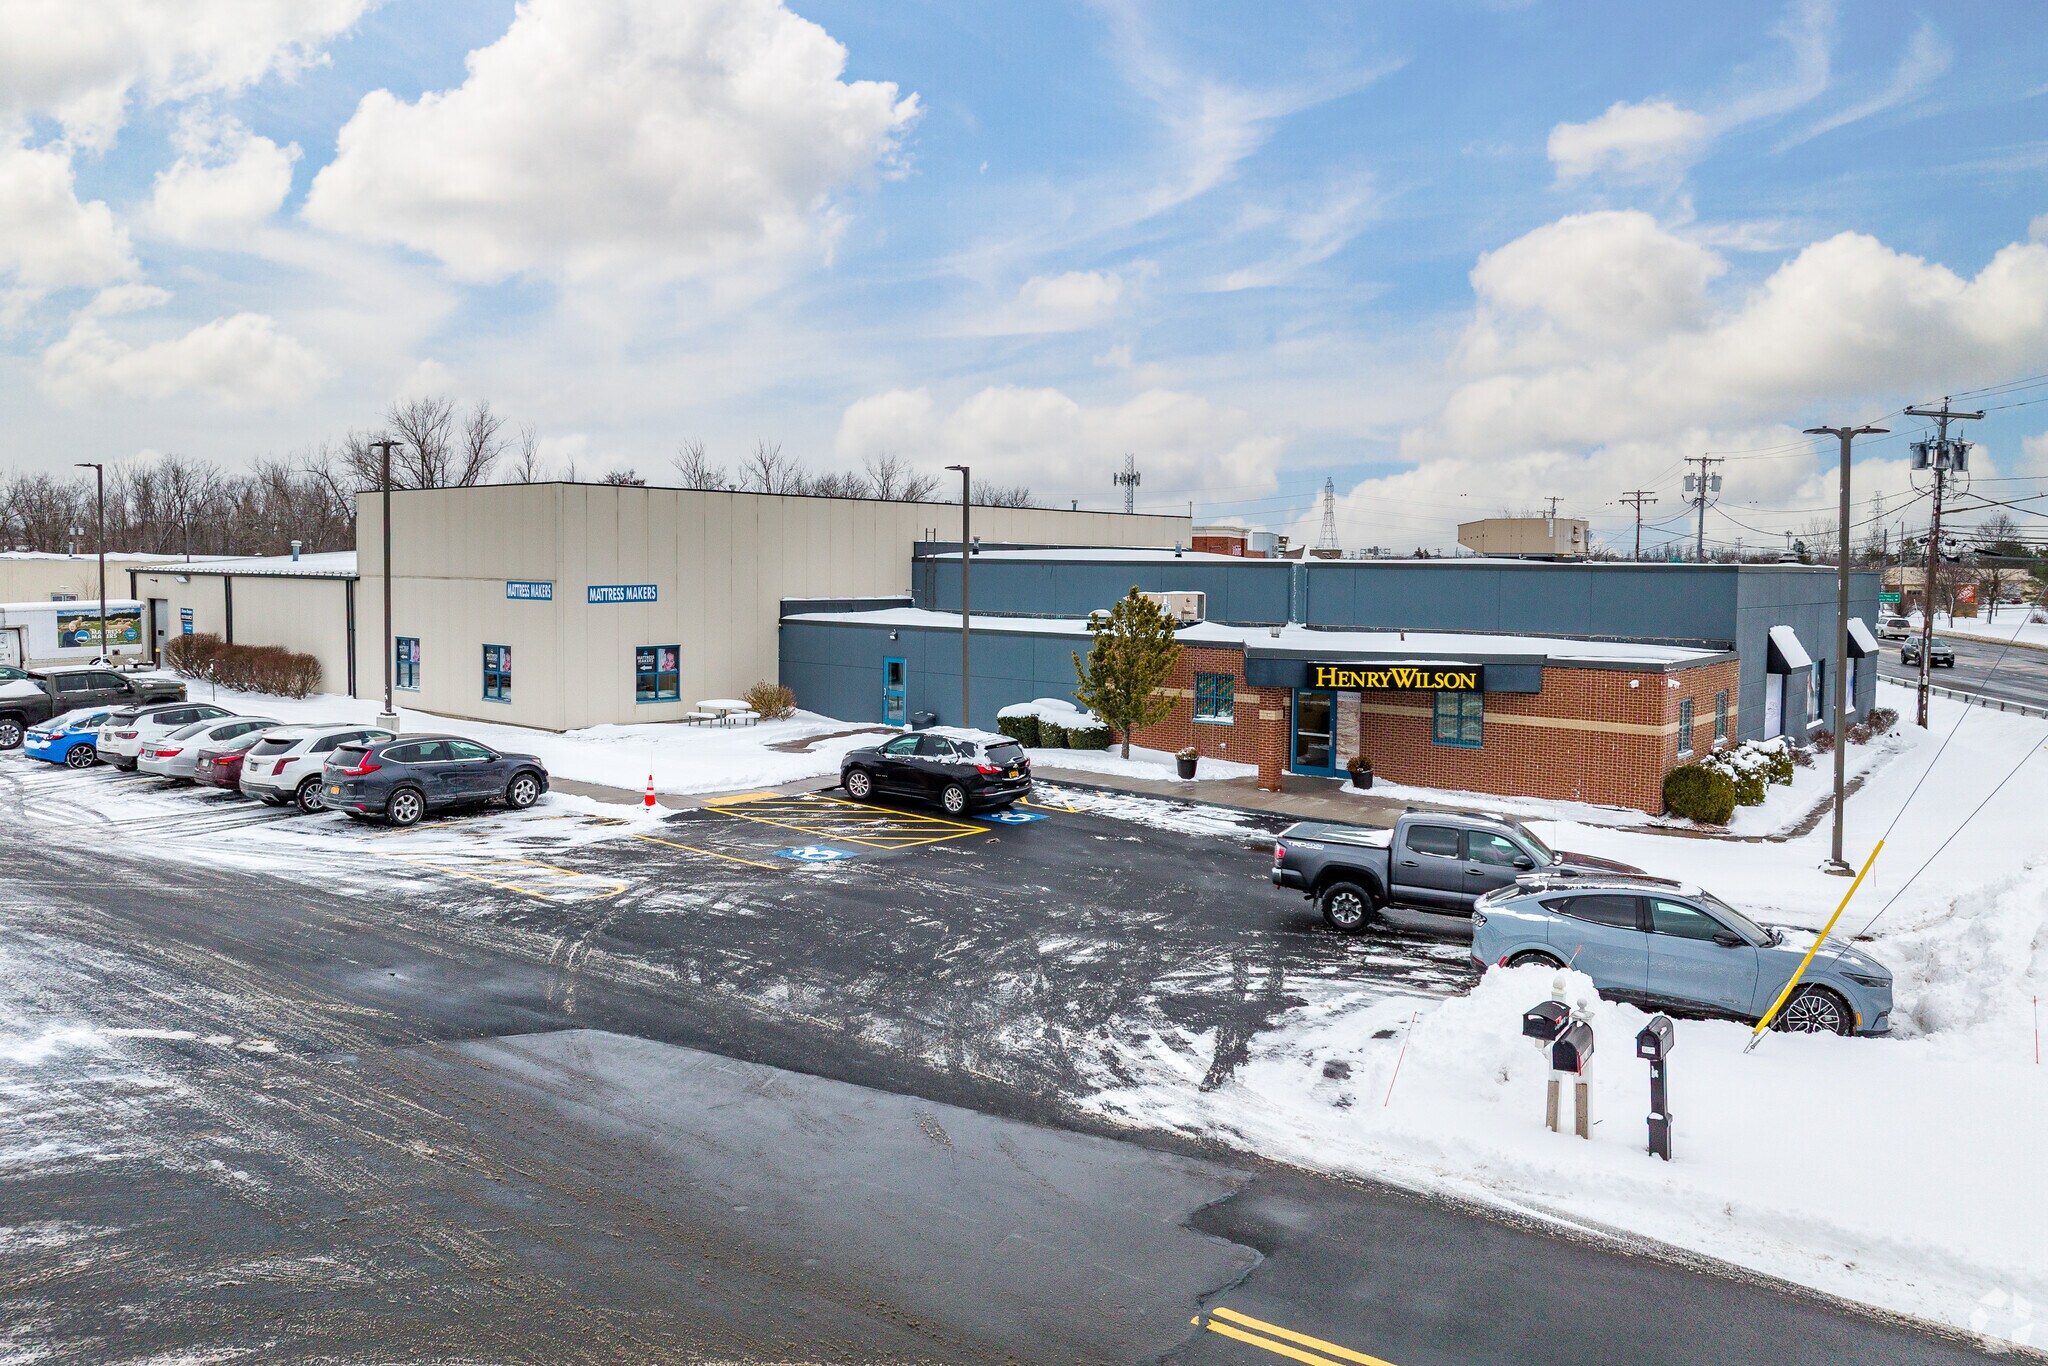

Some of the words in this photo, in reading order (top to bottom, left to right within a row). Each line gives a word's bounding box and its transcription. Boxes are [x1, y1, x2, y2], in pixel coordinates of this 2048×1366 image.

[507, 583, 530, 597] MATTRESS
[530, 584, 552, 599] MAKERS
[589, 587, 625, 601] MATTRESS
[626, 586, 656, 600] MAKERS
